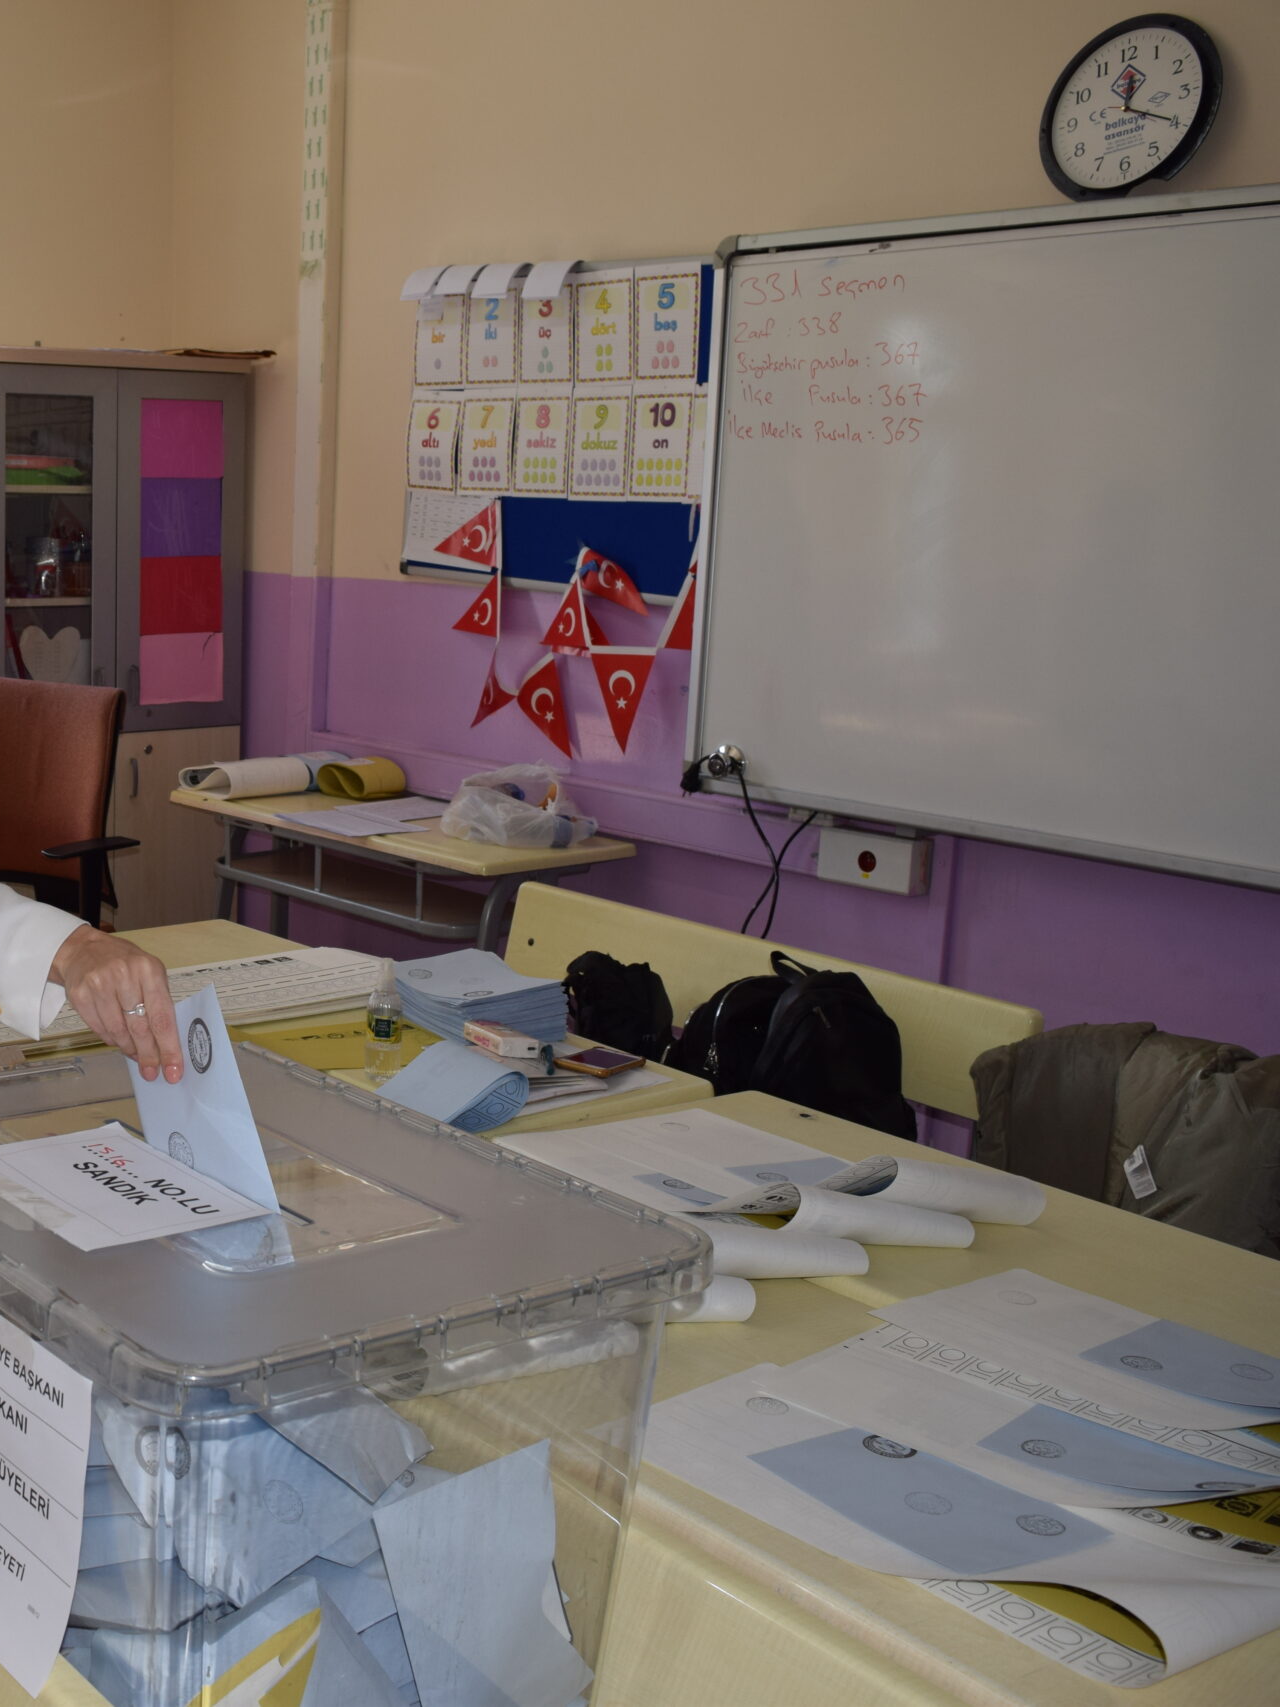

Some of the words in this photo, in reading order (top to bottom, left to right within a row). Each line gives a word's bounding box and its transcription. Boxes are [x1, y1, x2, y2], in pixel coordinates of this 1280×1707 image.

[1120, 45, 1138, 63] 12
[1154, 45, 1159, 60] 1
[1096, 62, 1109, 78] 11
[1172, 59, 1184, 75] 2
[1076, 88, 1091, 105] 10
[1178, 84, 1191, 99] 3
[1067, 117, 1078, 133] 9
[1104, 113, 1146, 131] balkaya
[1169, 115, 1181, 129] 4
[1074, 142, 1085, 157] 8
[1147, 141, 1159, 157] 5
[1095, 156, 1104, 172] 7
[1120, 156, 1131, 171] 6
[740, 268, 802, 306] 331
[595, 288, 612, 314] 4
[657, 283, 675, 310] 5
[485, 299, 499, 321] 2
[538, 300, 553, 318] 3
[484, 322, 497, 340] iki
[591, 317, 616, 336] dört
[654, 312, 677, 332] beş
[431, 327, 446, 344] bir
[538, 326, 552, 339] üç
[875, 341, 920, 366] 367
[878, 383, 928, 407] 367
[426, 408, 441, 430] 6
[480, 405, 495, 429] 7
[535, 404, 551, 429] 8
[593, 404, 609, 430] 9
[649, 402, 676, 428] 10
[526, 430, 557, 449] sekiz
[881, 416, 924, 445] 365
[472, 430, 497, 450] yedi
[581, 432, 618, 450] dokuz
[652, 438, 669, 449] on
[72, 1161, 159, 1206] SANDIK
[143, 1178, 221, 1216] NO.LU
[12, 1358, 65, 1409] BAŞKANI
